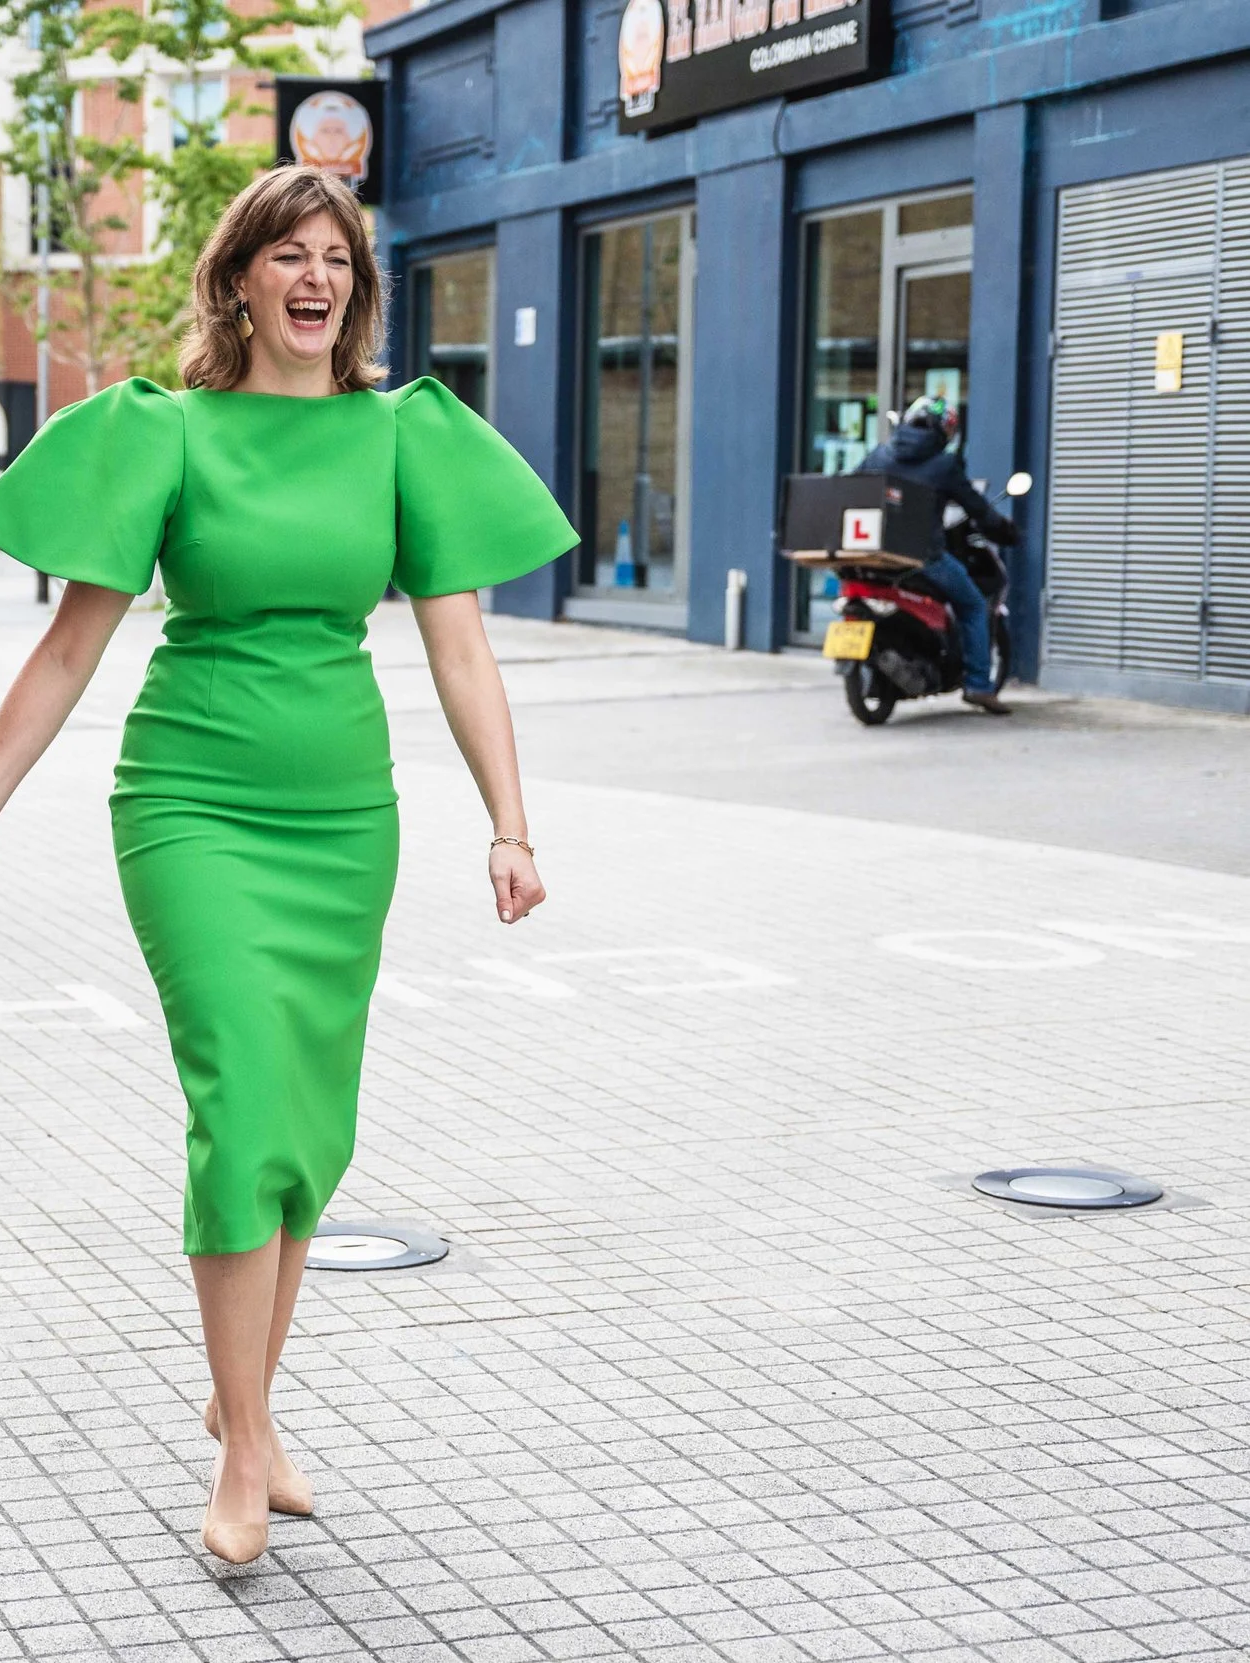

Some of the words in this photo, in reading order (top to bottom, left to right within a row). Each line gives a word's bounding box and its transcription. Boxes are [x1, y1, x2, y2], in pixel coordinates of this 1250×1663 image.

[749, 33, 812, 73] COLOMBIAN
[812, 19, 859, 54] CUISINE
[854, 520, 869, 539] L
